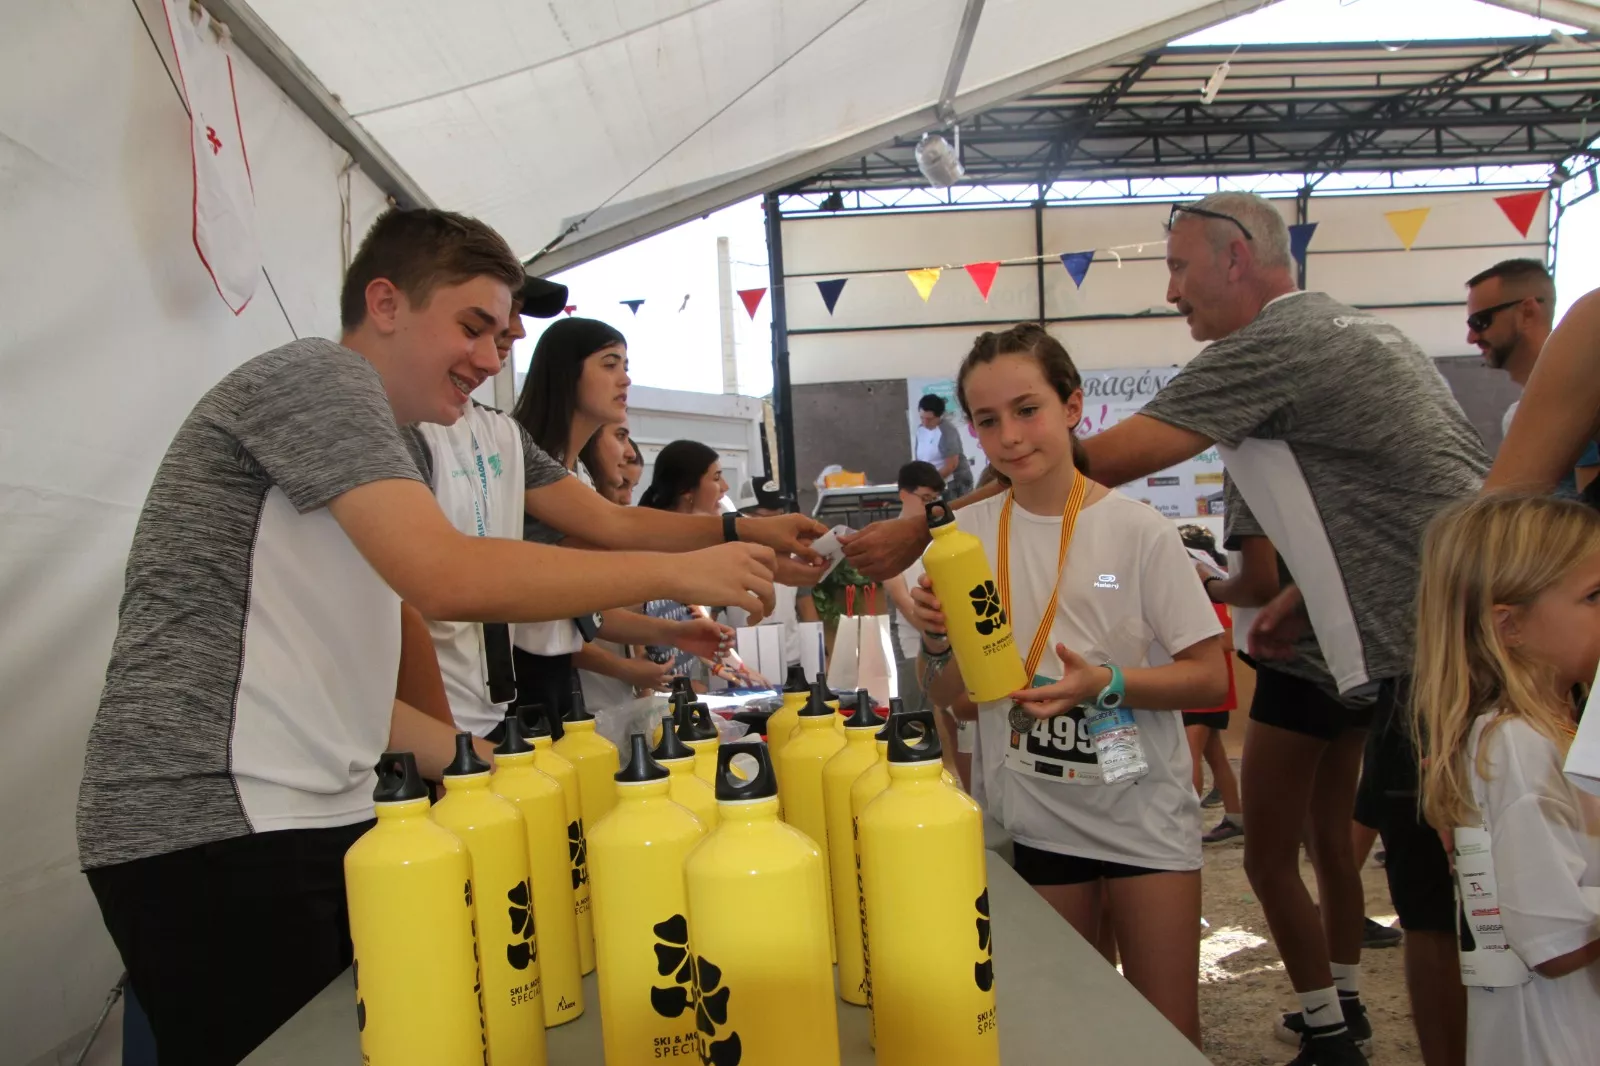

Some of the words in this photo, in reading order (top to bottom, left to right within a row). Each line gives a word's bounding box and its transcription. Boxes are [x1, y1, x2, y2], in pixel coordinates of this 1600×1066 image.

[1031, 715, 1097, 754] 499
[510, 986, 522, 996] SKI
[977, 1011, 988, 1023] SKI
[654, 1037, 671, 1046] SKI
[675, 1035, 681, 1043] &
